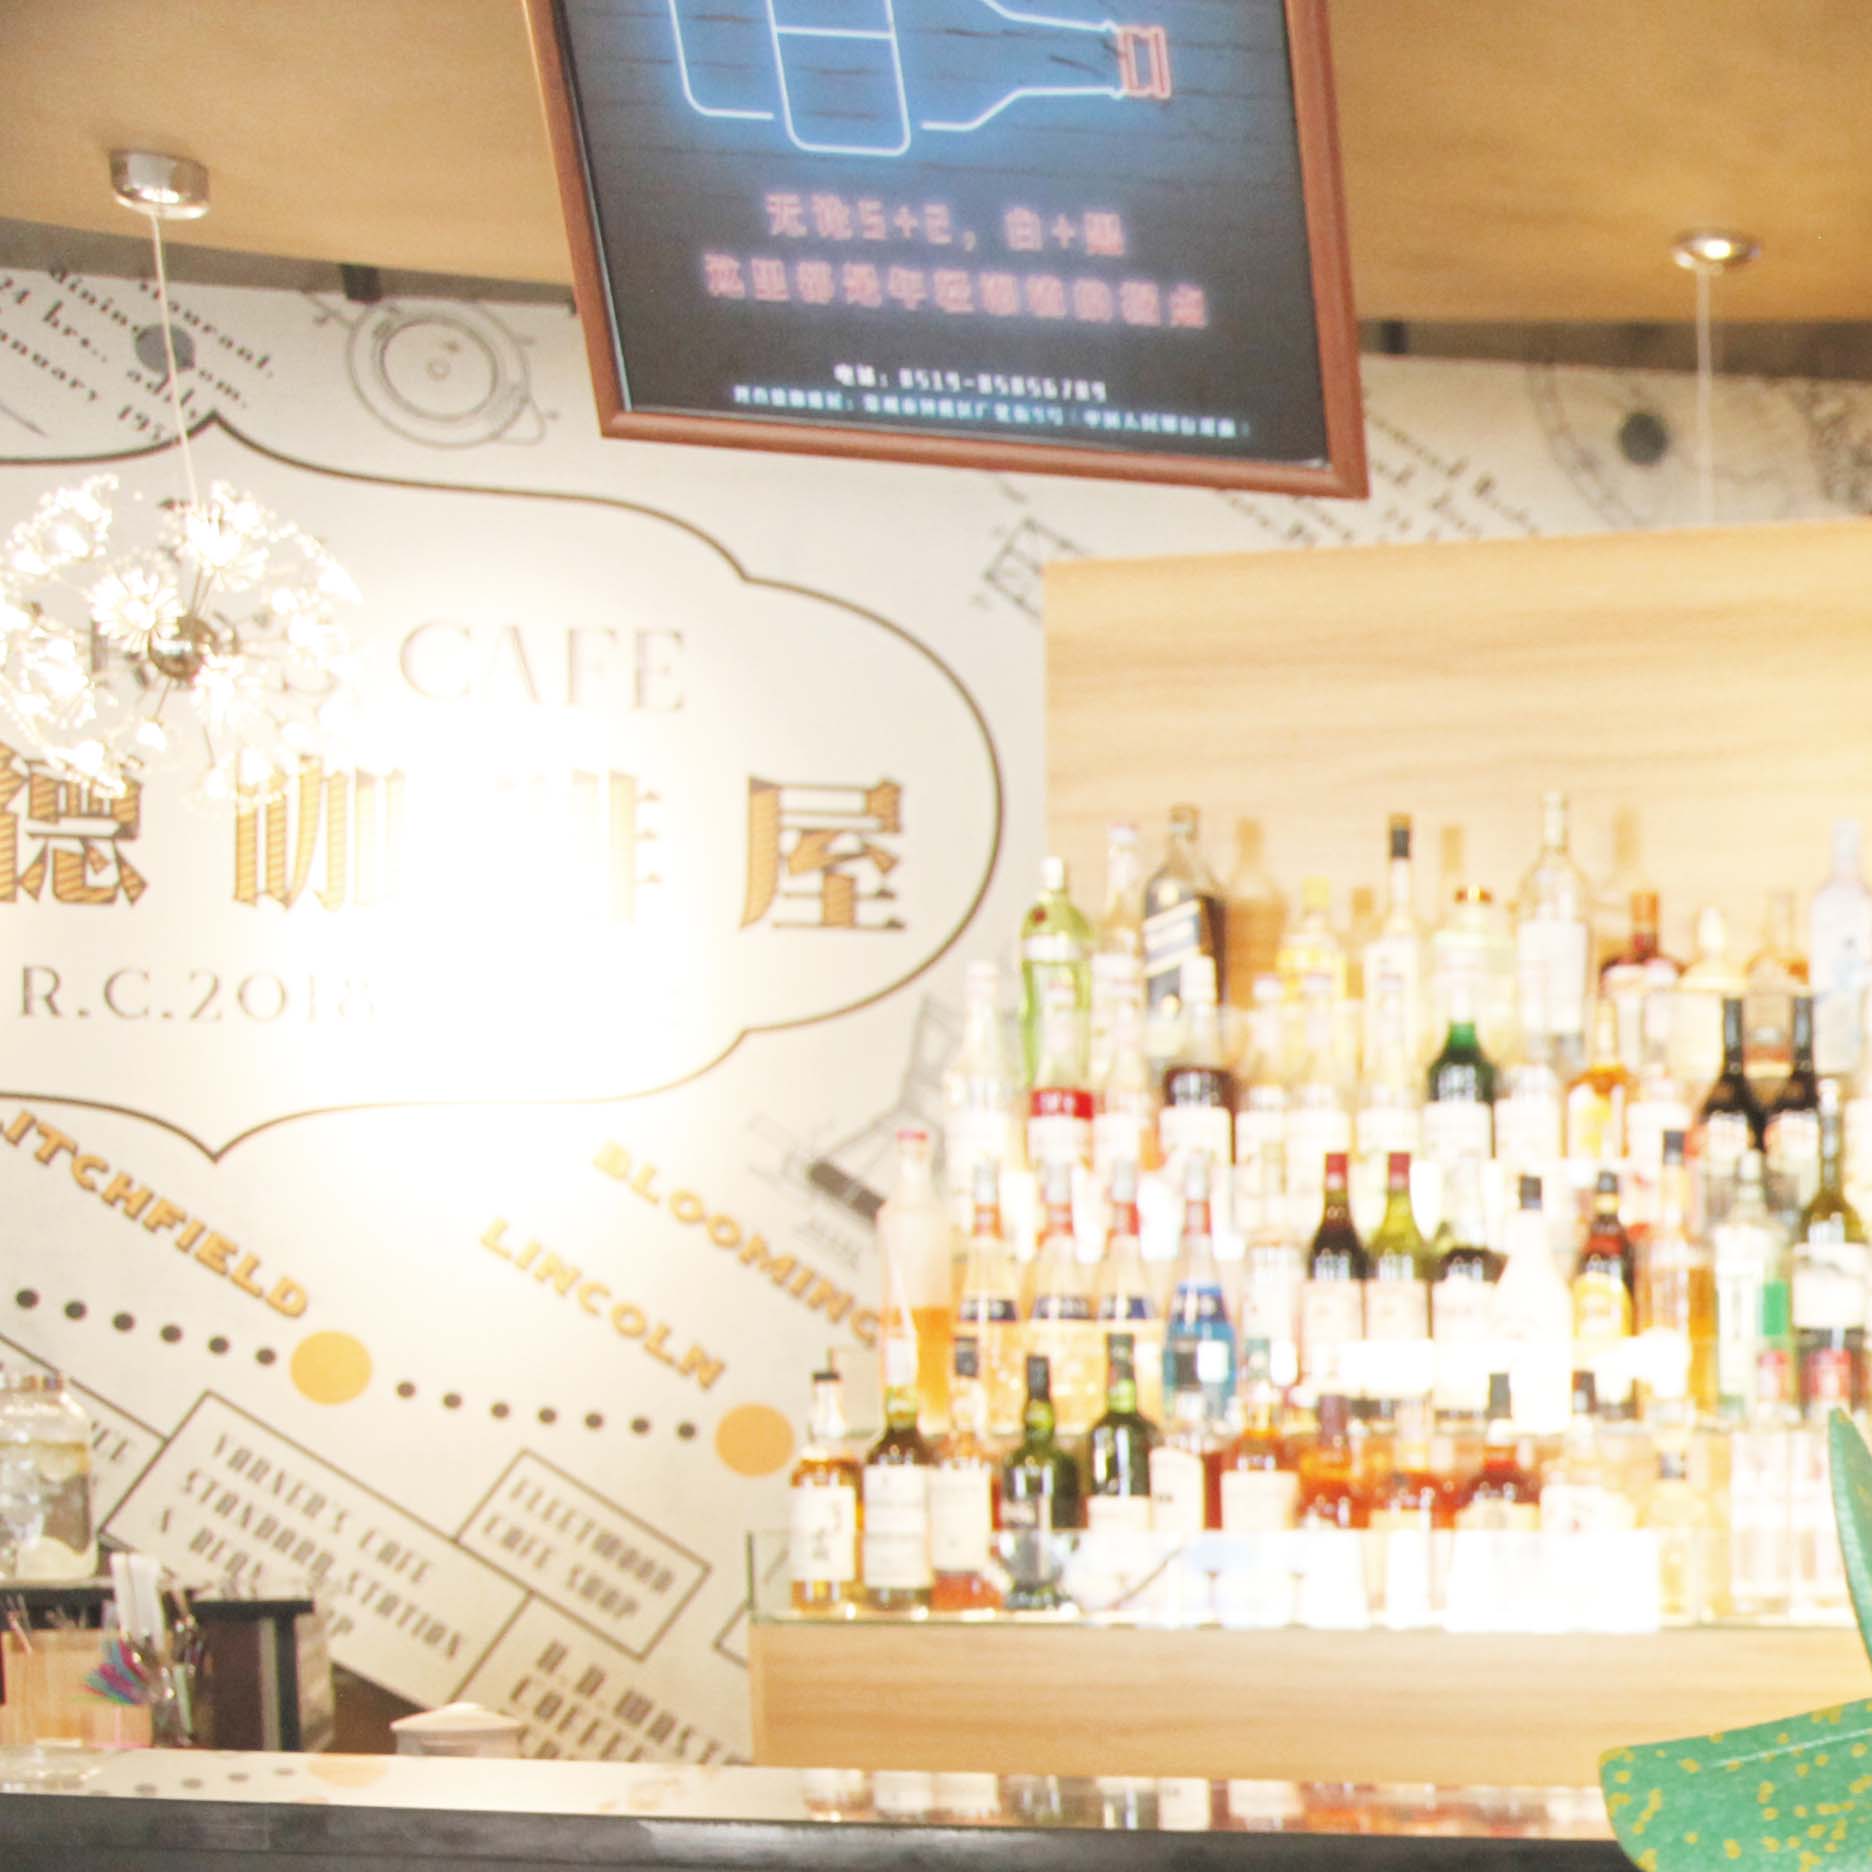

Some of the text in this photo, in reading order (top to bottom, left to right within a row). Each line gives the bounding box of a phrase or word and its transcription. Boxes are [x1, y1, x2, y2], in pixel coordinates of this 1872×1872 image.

[400, 618, 690, 714] CAFE
[0, 1109, 309, 1320] ITCHFIELD
[479, 1214, 727, 1392] LINCOLN
